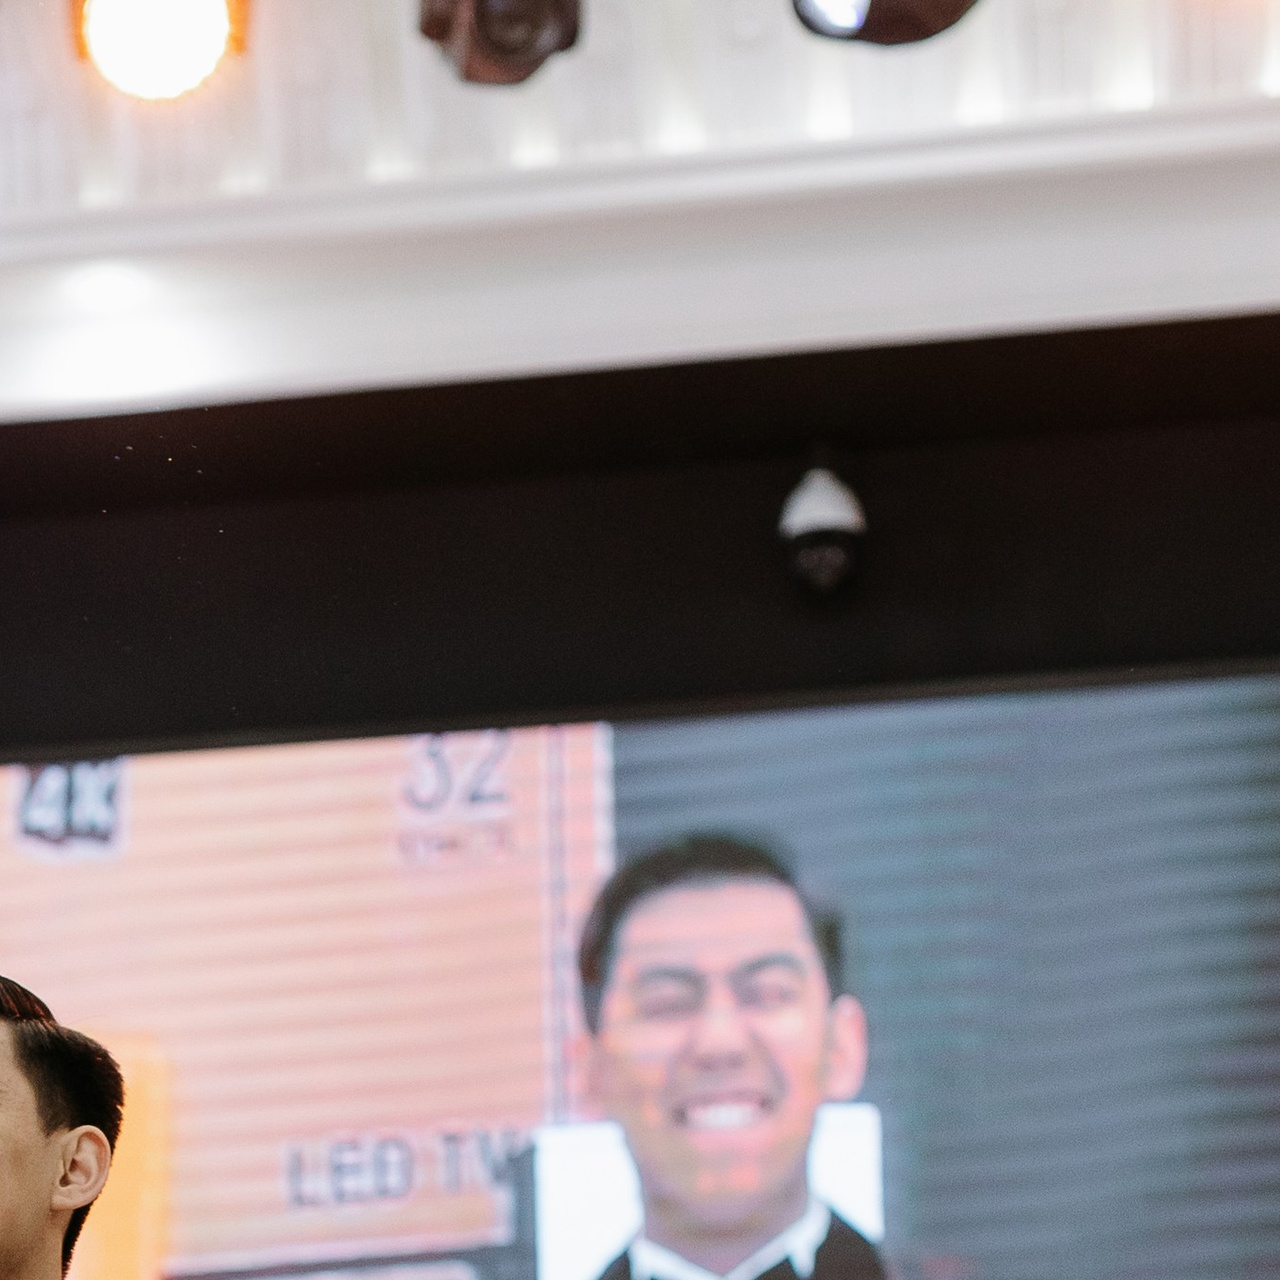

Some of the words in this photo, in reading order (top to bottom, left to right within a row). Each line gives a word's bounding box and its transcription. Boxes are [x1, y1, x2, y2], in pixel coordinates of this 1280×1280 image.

[22, 762, 111, 834] 4K
[402, 729, 508, 808] 32
[287, 1138, 414, 1206] LED
